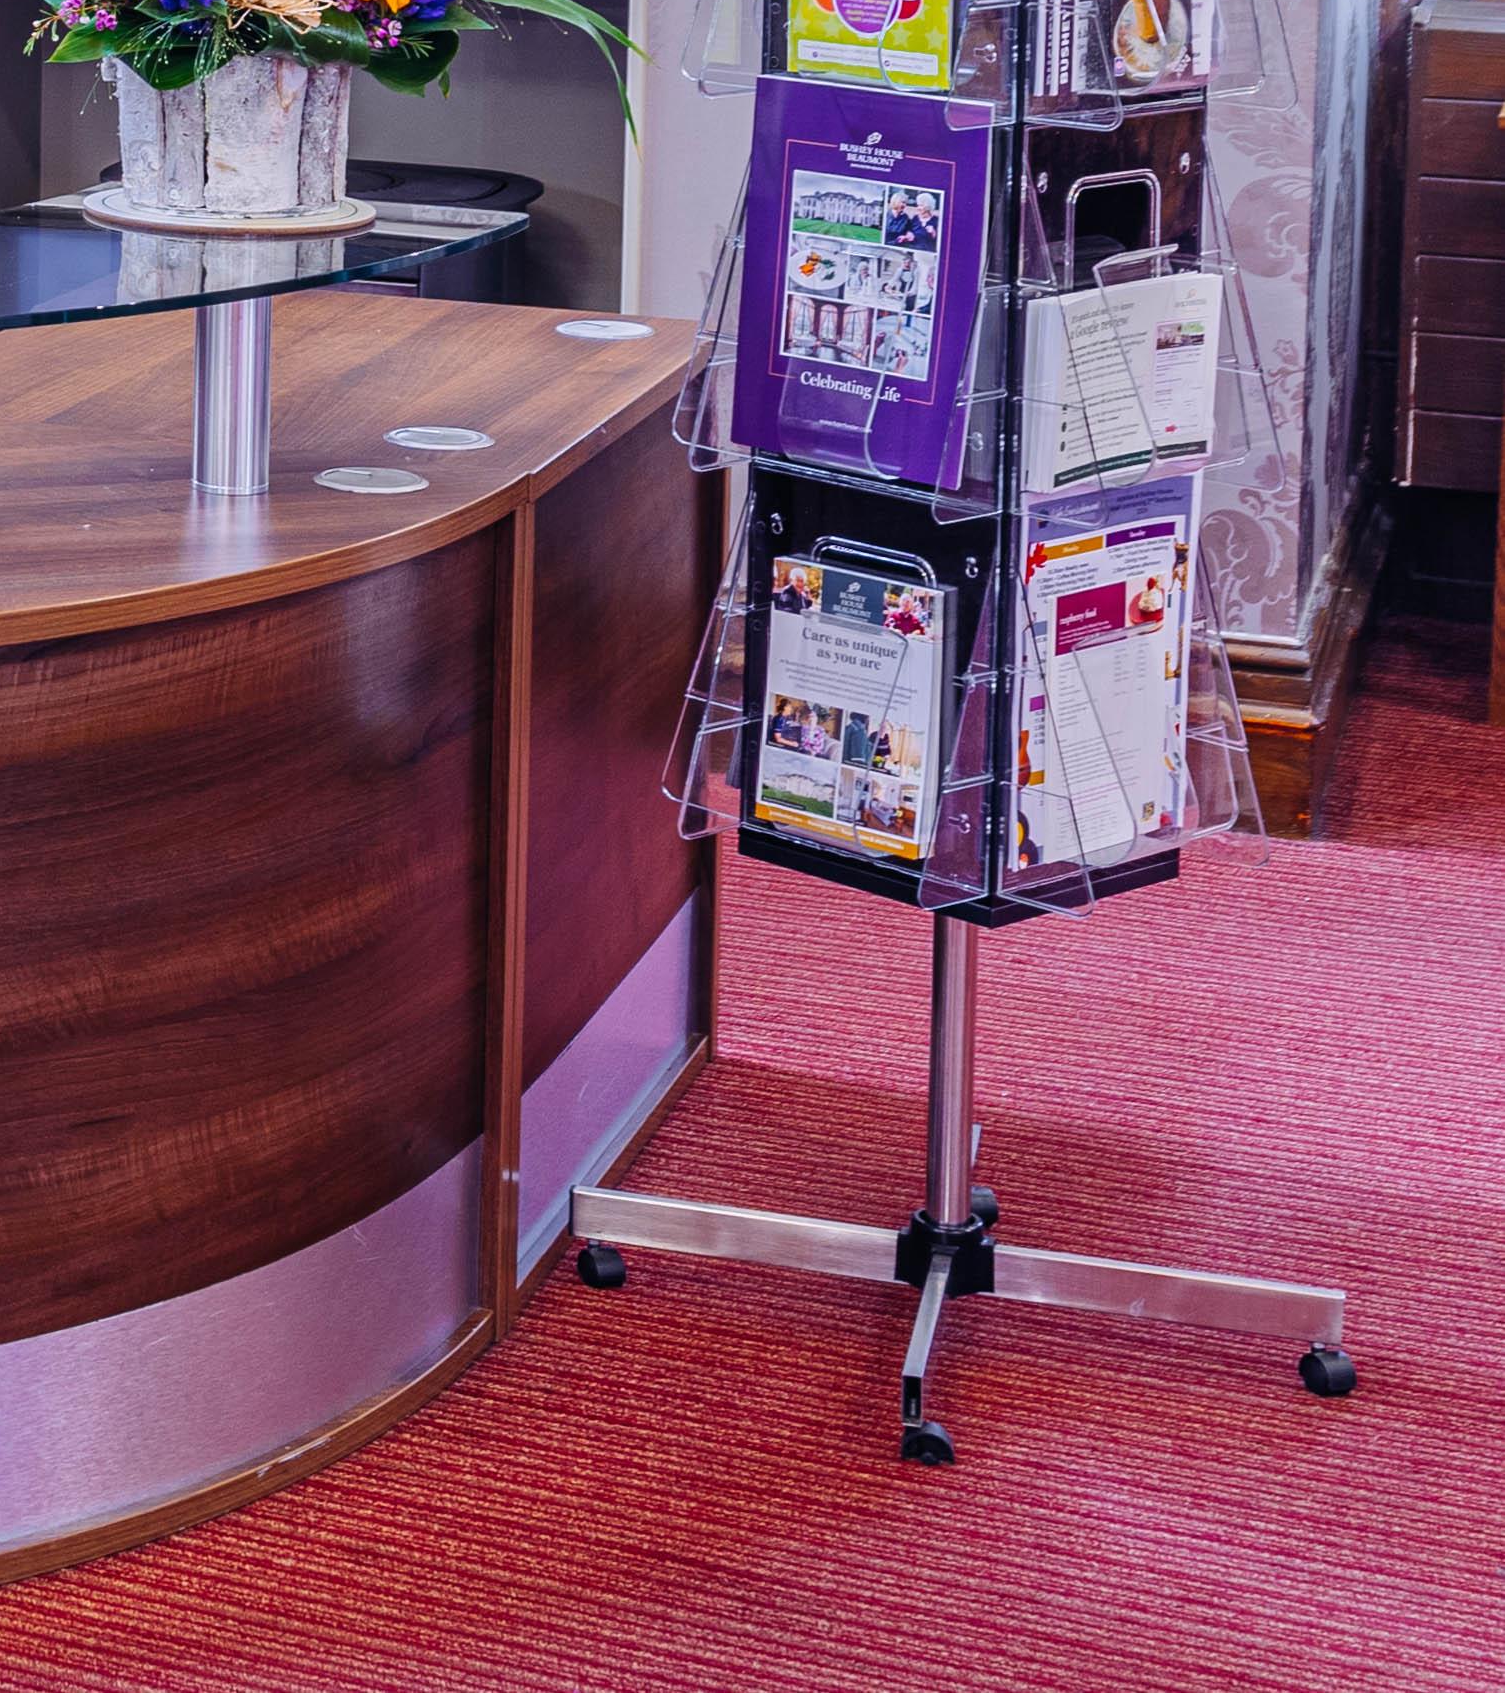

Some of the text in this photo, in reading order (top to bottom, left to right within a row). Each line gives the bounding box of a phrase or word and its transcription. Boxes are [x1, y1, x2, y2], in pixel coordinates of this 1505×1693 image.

[1060, 9, 1073, 85] BUSHEY
[800, 371, 874, 401] Celebrating
[802, 626, 898, 659] Care as unique
[816, 647, 882, 671] as you are
